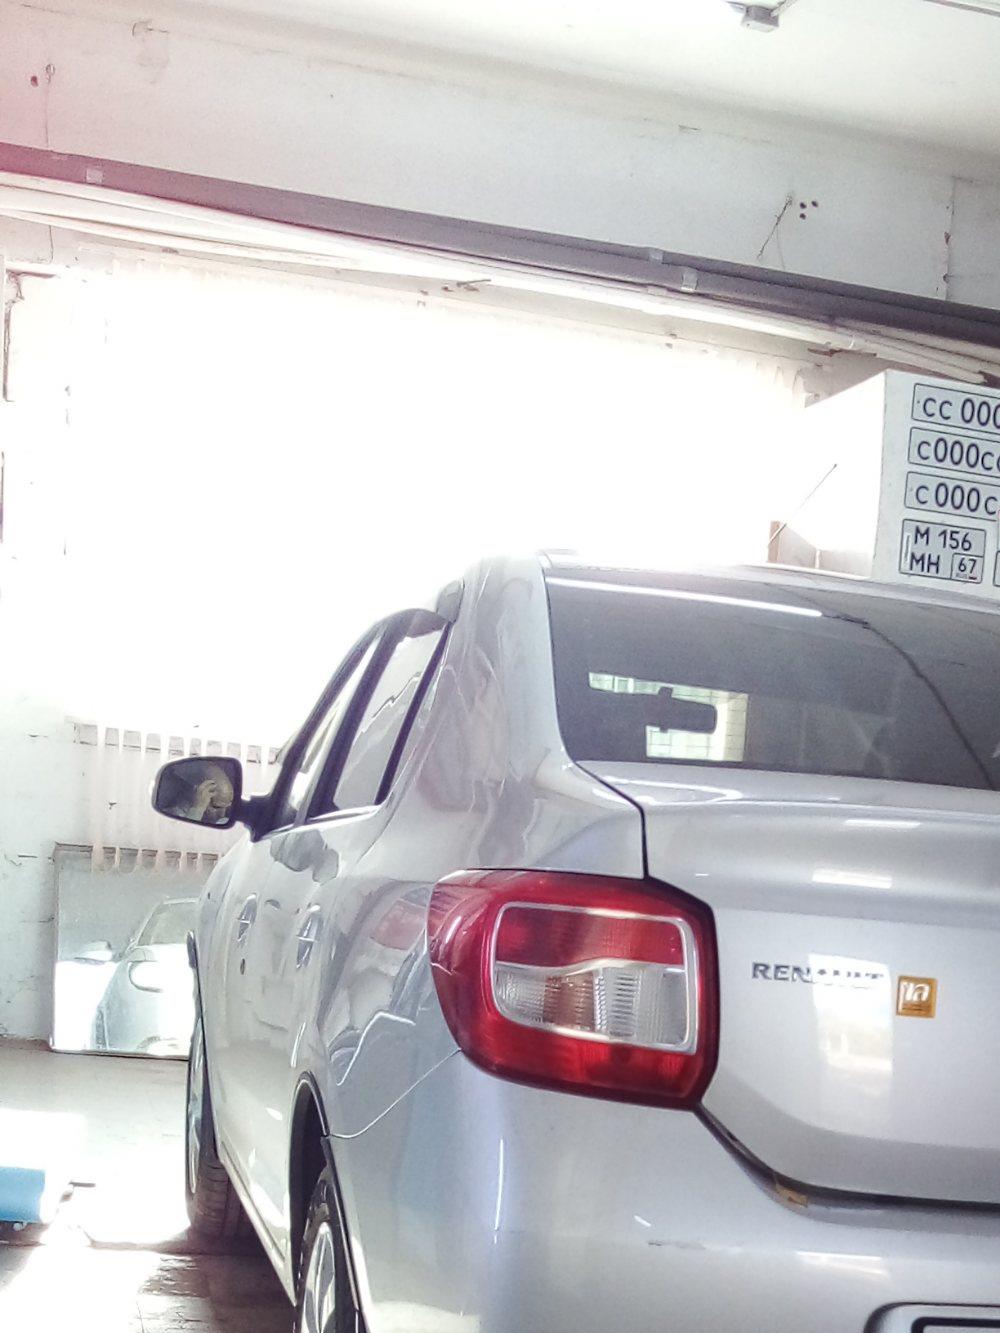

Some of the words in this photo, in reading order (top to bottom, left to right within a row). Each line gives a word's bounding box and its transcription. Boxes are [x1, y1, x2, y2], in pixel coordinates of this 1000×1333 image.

[914, 525, 931, 546] М
[938, 529, 972, 552] 156
[909, 552, 941, 575] МН
[958, 557, 977, 574] 67
